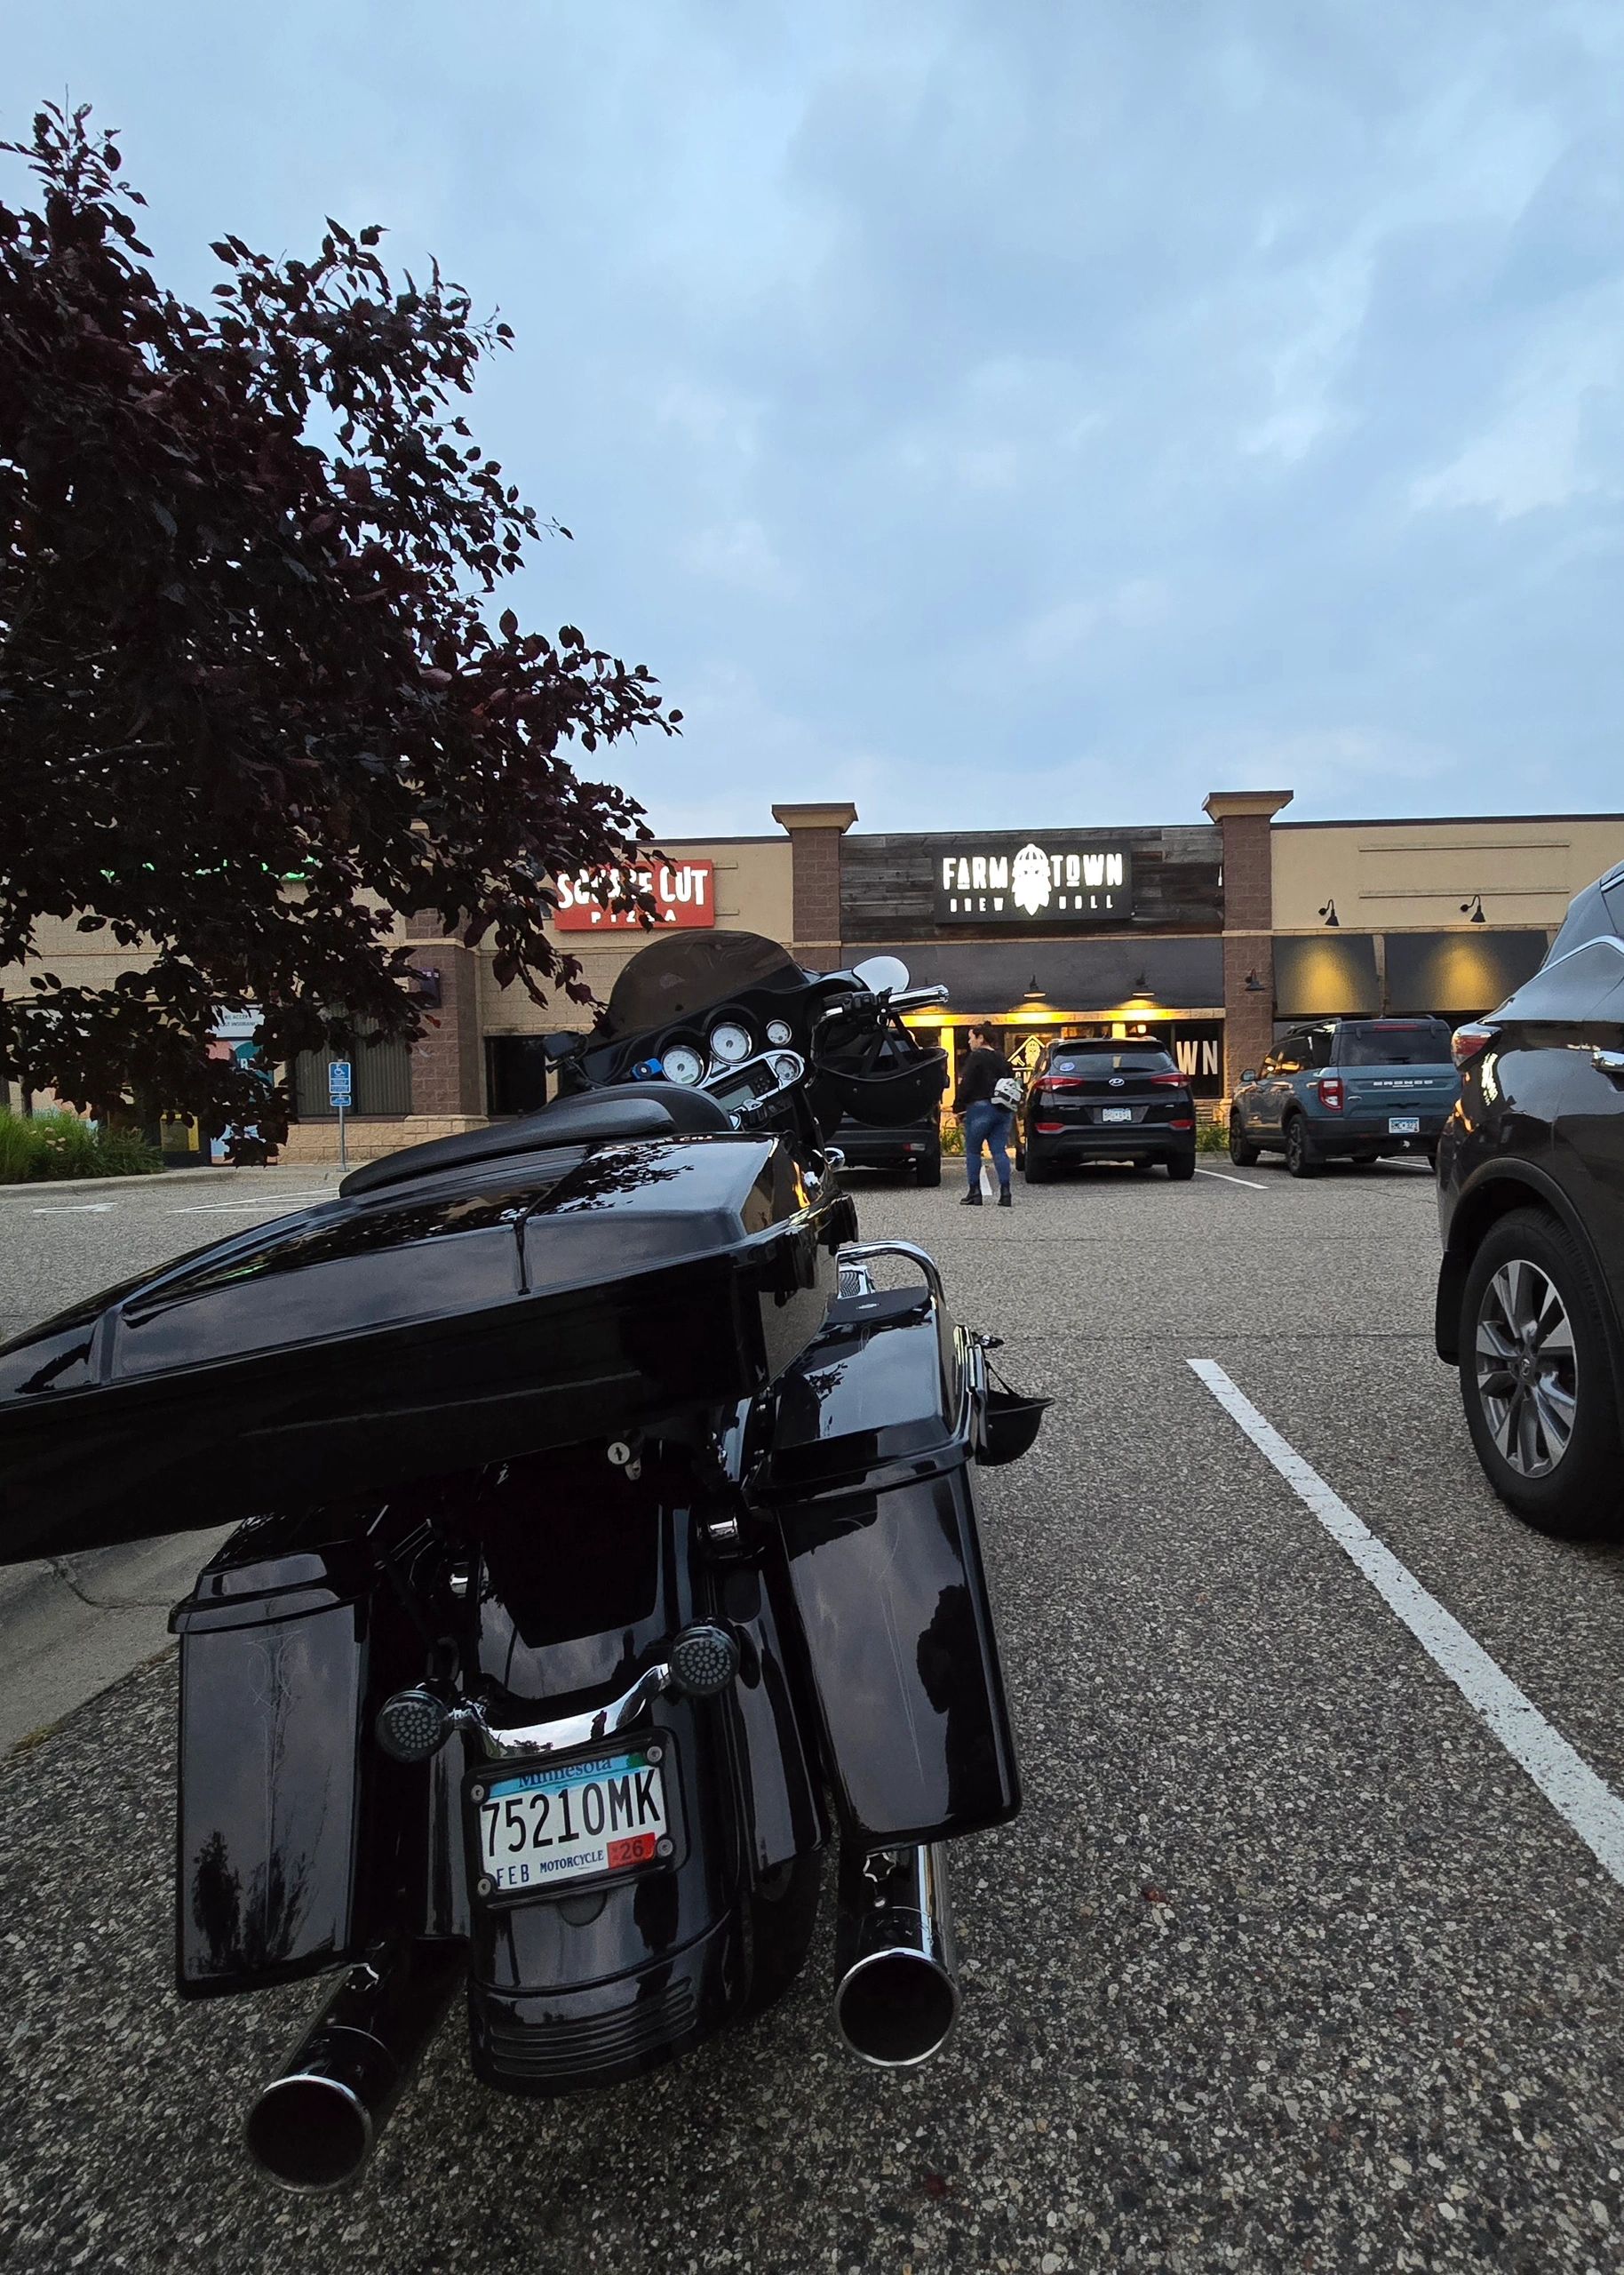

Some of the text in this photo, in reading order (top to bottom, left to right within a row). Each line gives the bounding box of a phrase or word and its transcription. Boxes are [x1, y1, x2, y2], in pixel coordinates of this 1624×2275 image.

[660, 866, 708, 905] CUT
[943, 854, 1122, 890] FARM TOWN
[519, 1760, 612, 1788] Minnesota
[482, 1768, 661, 1857] 75210MK
[496, 1864, 530, 1888] FEB
[539, 1849, 604, 1873] MOTORCYCLE
[619, 1841, 642, 1861] 26
